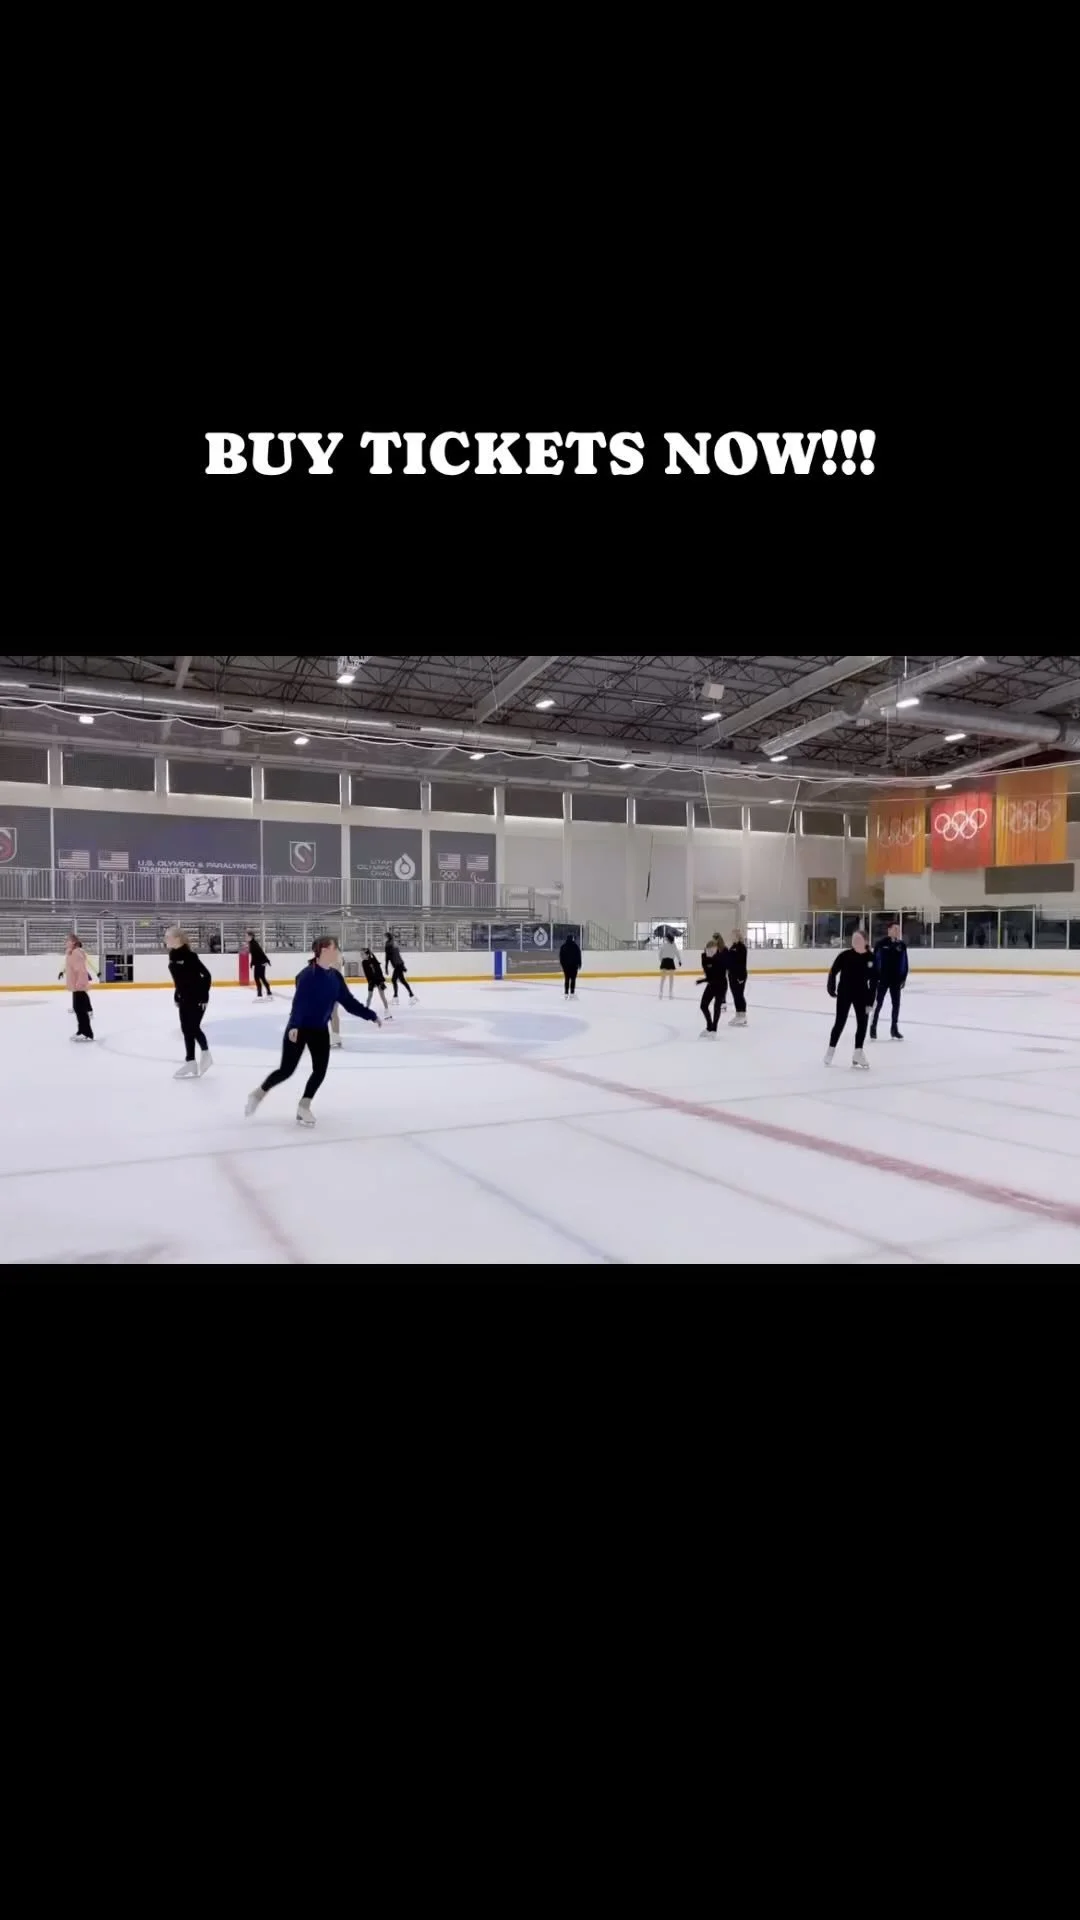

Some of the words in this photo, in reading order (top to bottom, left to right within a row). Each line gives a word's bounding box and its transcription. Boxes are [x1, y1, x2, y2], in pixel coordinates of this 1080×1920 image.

[157, 860, 196, 868] OLYMPIC
[206, 862, 258, 870] PARALYMPIC
[138, 866, 180, 874] TRAINING
